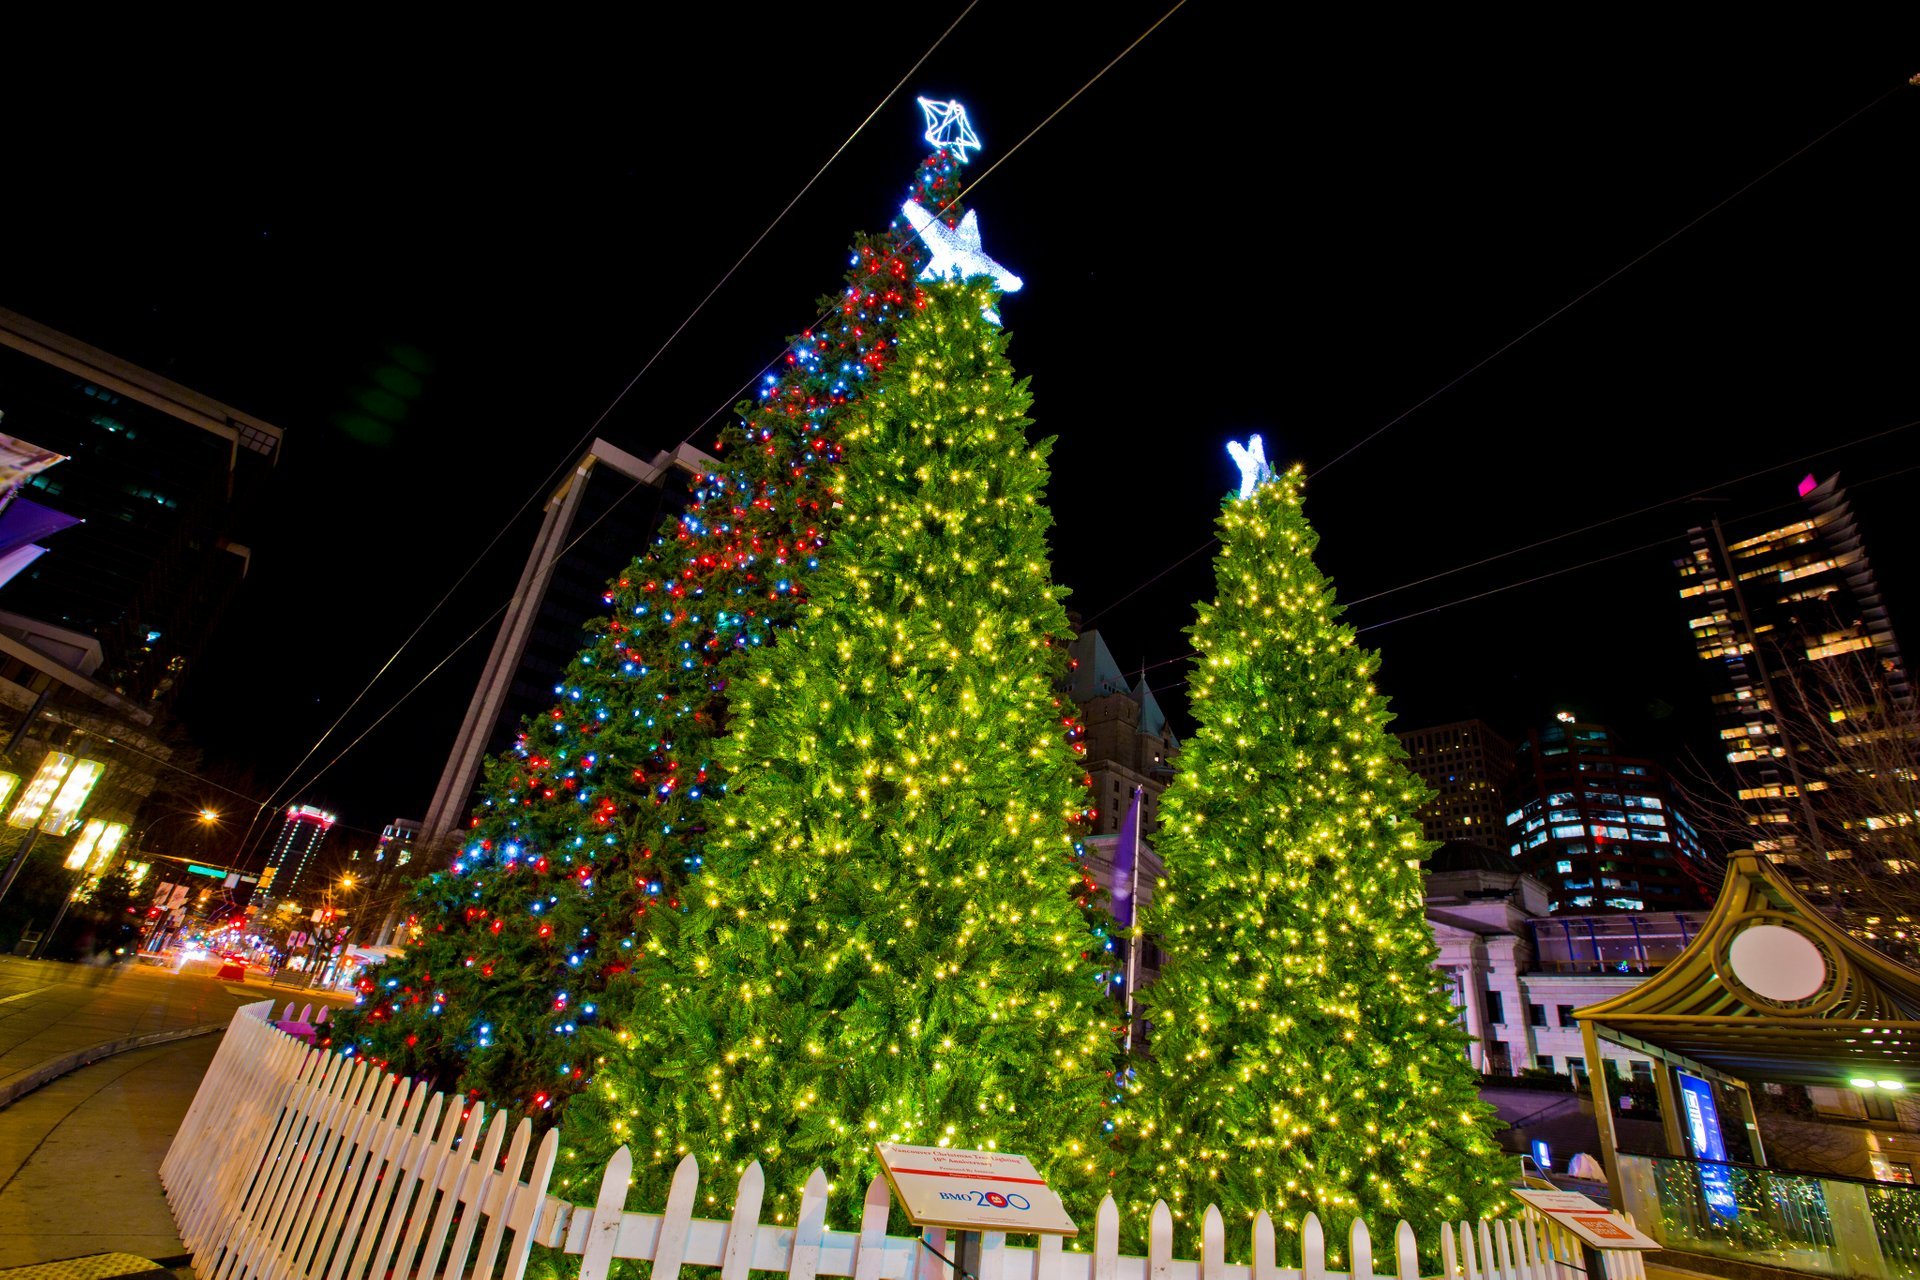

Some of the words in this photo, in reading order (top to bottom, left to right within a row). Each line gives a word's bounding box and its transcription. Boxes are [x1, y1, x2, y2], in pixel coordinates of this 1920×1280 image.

[892, 1147, 931, 1156] Vancouver
[932, 1151, 972, 1159] Christmas
[990, 1156, 1021, 1165] Lighting
[949, 1159, 993, 1167] Anniversary
[940, 1192, 972, 1201] BMO
[970, 1191, 1030, 1210] 200
